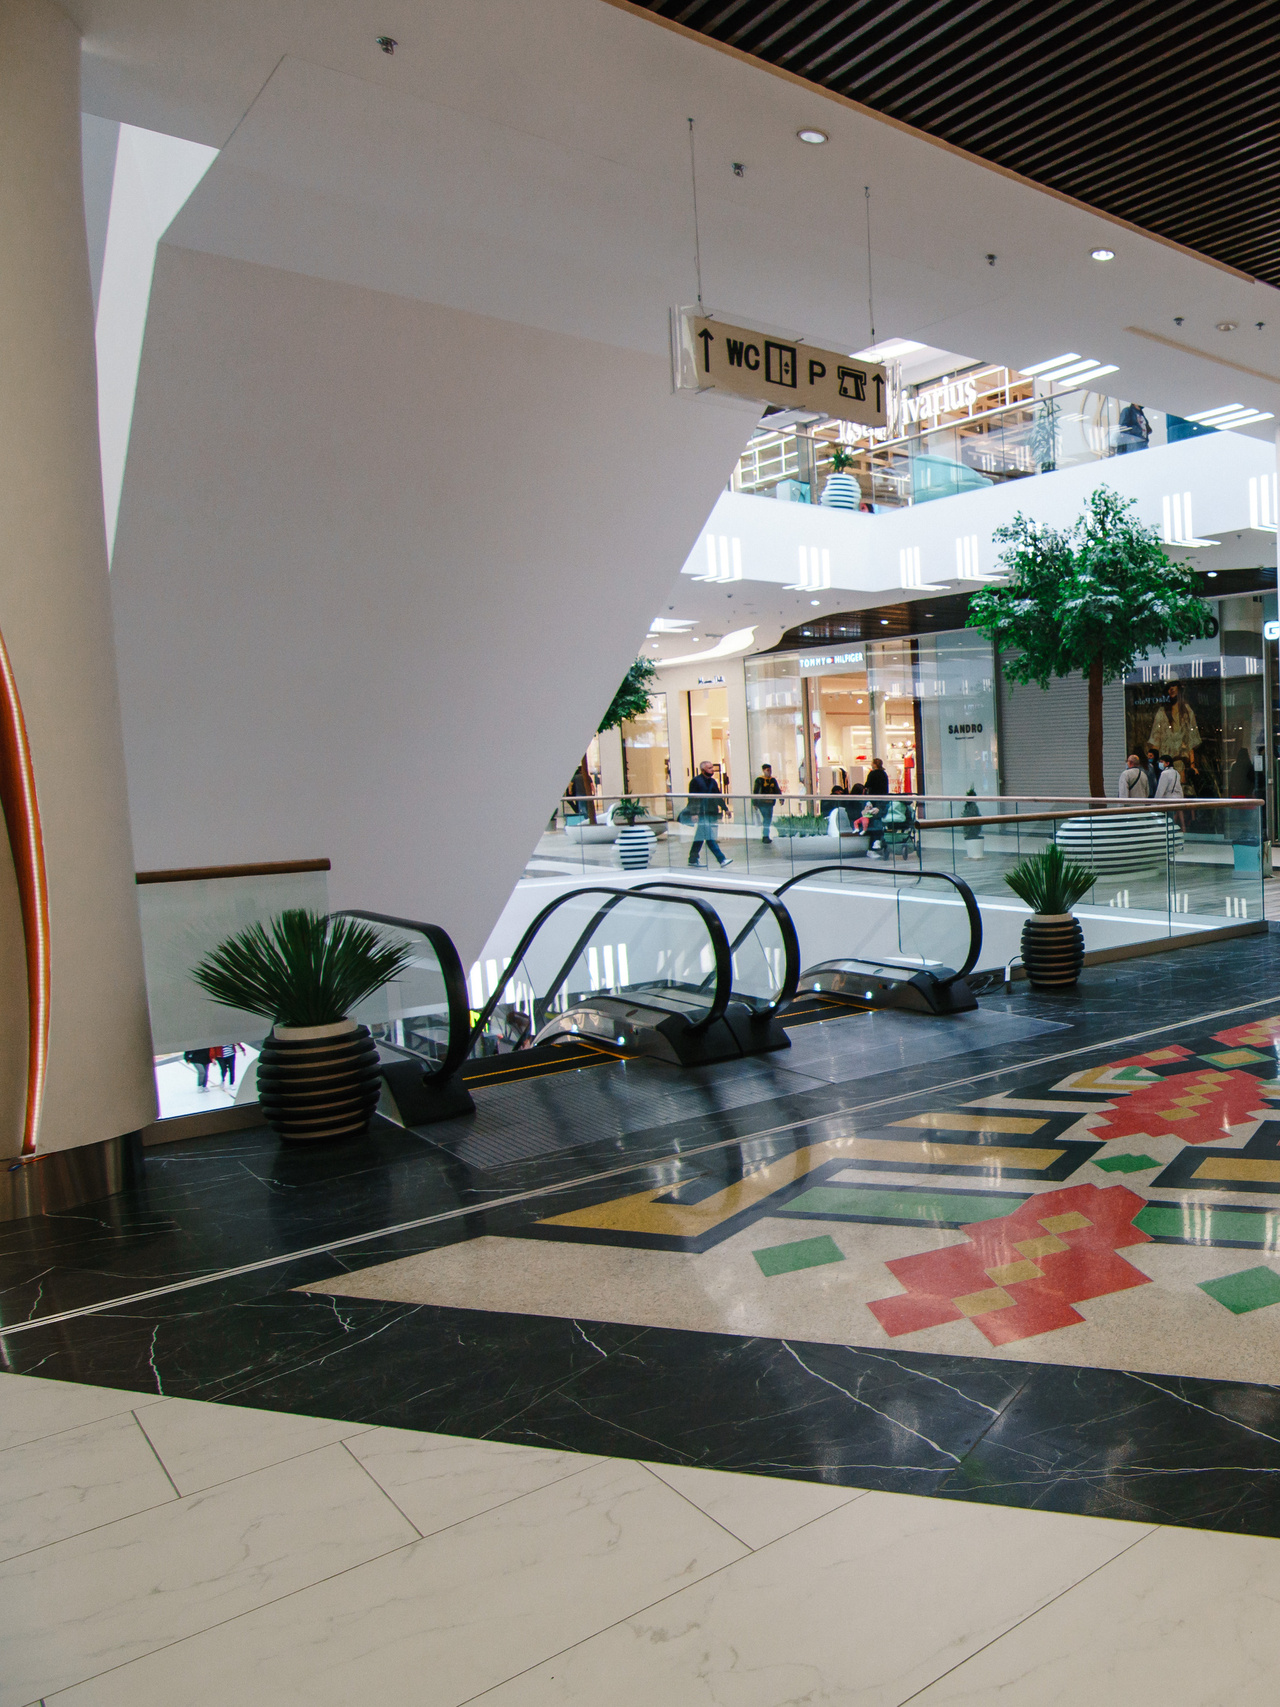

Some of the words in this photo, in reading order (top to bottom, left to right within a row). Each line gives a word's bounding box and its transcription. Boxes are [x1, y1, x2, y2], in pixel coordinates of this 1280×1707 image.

[726, 338, 760, 371] WC
[809, 359, 826, 385] P
[799, 657, 825, 668] TOMMY
[834, 652, 863, 664] HILFIGER
[948, 723, 983, 734] SANDRO
